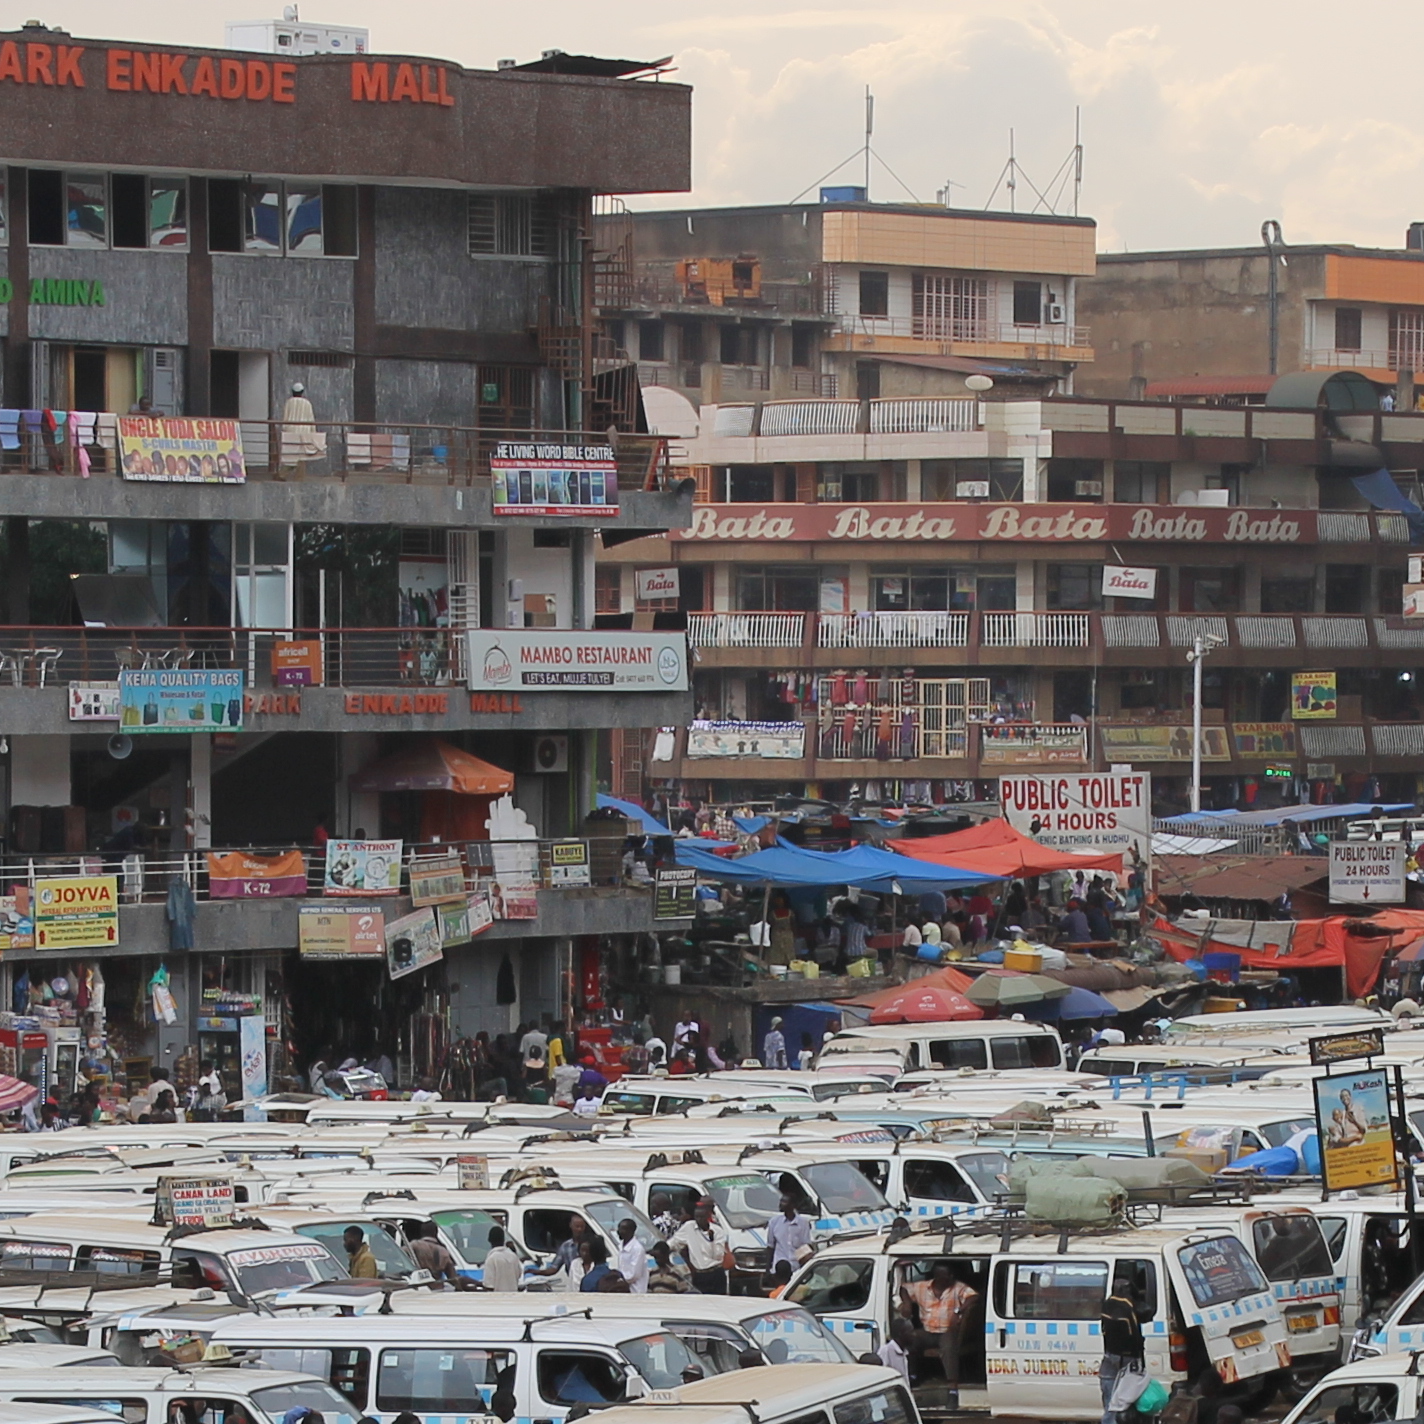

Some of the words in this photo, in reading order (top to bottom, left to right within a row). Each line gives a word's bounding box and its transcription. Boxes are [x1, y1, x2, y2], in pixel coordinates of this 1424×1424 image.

[105, 49, 296, 104] ENKADDE
[350, 61, 455, 107] MALL
[29, 278, 106, 306] AMINA
[119, 417, 160, 438] UNCLE
[196, 420, 236, 440] SALON
[182, 440, 217, 450] MASTER
[509, 445, 535, 459] LIVING
[536, 446, 562, 459] WORD
[562, 446, 583, 460] BIBLE
[584, 446, 615, 460] CENTRE
[680, 508, 795, 540] Bata
[827, 508, 956, 540] Bata
[978, 508, 1106, 540] Bata
[1129, 509, 1207, 540] Bata
[1223, 511, 1301, 542] Bata
[646, 578, 675, 592] Bata
[1110, 576, 1149, 590] Bata
[278, 647, 308, 657] africell
[521, 646, 573, 664] MAMBO
[577, 646, 653, 664] RESTAURANT
[125, 672, 157, 686] KEMA
[159, 672, 207, 687] QUALITY
[210, 672, 240, 686] BAGS
[527, 673, 545, 684] LET'S
[563, 673, 587, 684] MUJJE
[243, 693, 300, 714] PARK
[344, 692, 449, 714] ENKADDE
[470, 693, 524, 714] MALL
[1002, 779, 1069, 810] PUBLIC
[1078, 776, 1143, 809] TOILET
[1057, 811, 1117, 830] HOURS
[1059, 834, 1092, 845] BATHING
[1334, 846, 1365, 861] PUBLIC
[1367, 846, 1396, 861] TOILET
[1345, 865, 1357, 876] 24
[1359, 865, 1390, 877] HOURS
[54, 886, 110, 904] JOYVA
[354, 930, 378, 939] airtel
[173, 1190, 204, 1200] CANAN
[207, 1188, 232, 1198] LAND
[987, 1358, 1019, 1375] IBRA
[1023, 1359, 1070, 1376] JUNIOR
[651, 1391, 672, 1400] TAXI
